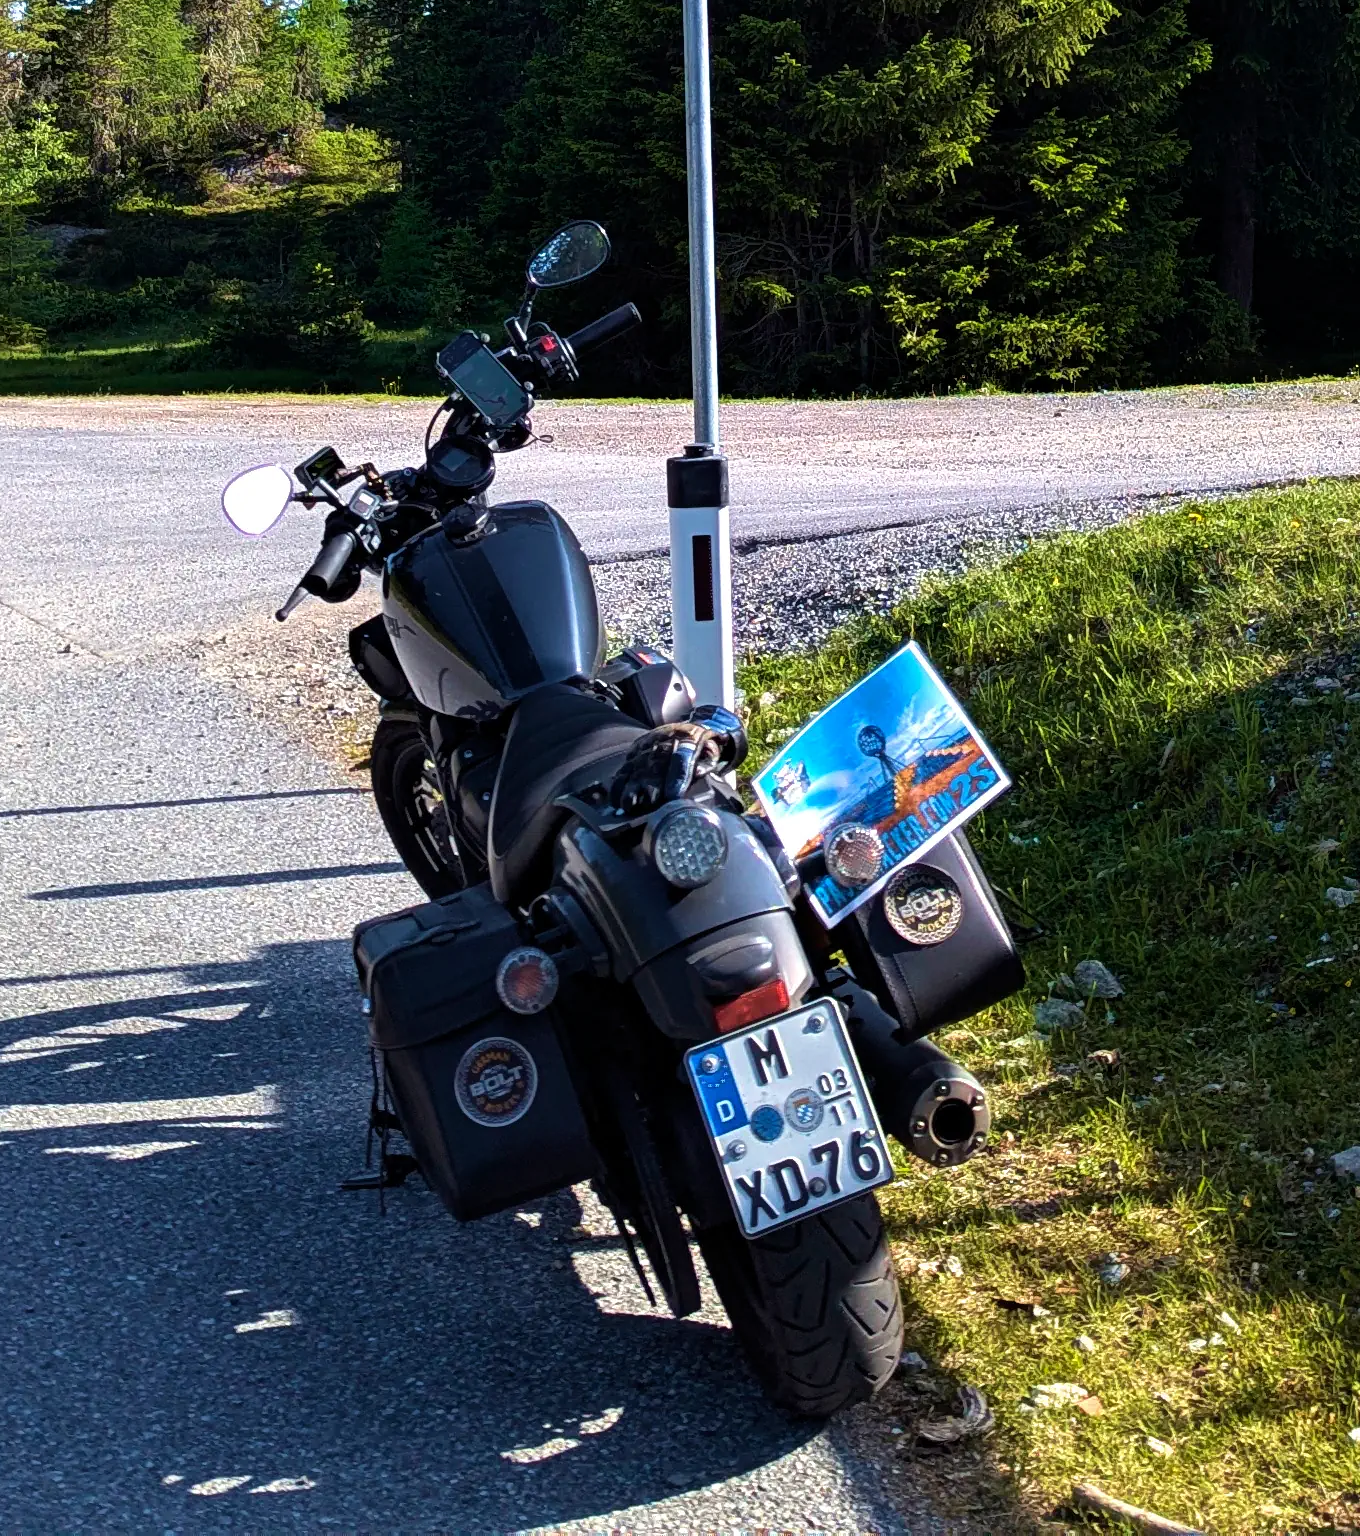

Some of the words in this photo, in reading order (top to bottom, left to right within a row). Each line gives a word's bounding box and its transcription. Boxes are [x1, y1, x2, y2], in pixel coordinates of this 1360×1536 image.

[950, 756, 997, 809] 25
[898, 887, 947, 919] BOLT
[917, 911, 951, 932] RIDERS
[746, 1028, 790, 1086] M
[469, 1065, 524, 1097] BOLT
[816, 1068, 849, 1096] 03
[716, 1099, 736, 1124] D
[830, 1099, 859, 1127] 11
